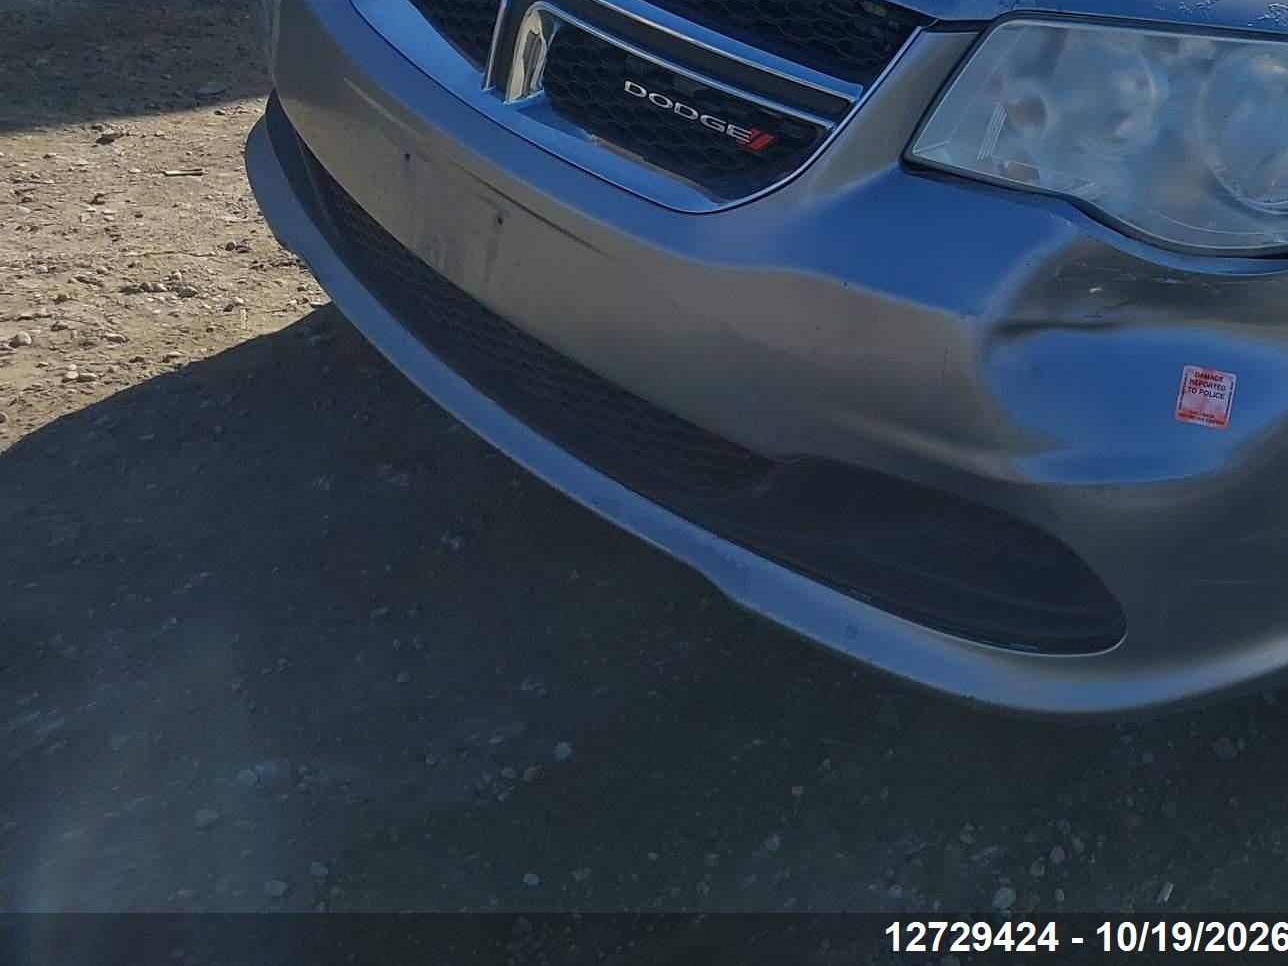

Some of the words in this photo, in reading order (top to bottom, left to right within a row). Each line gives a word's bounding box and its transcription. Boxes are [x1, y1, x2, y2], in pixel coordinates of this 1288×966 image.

[624, 80, 752, 143] DODGE
[1194, 371, 1224, 383] DAMAGE
[1189, 378, 1227, 391] REPORTED
[1188, 386, 1197, 394] TO
[1199, 388, 1226, 400] POLICE
